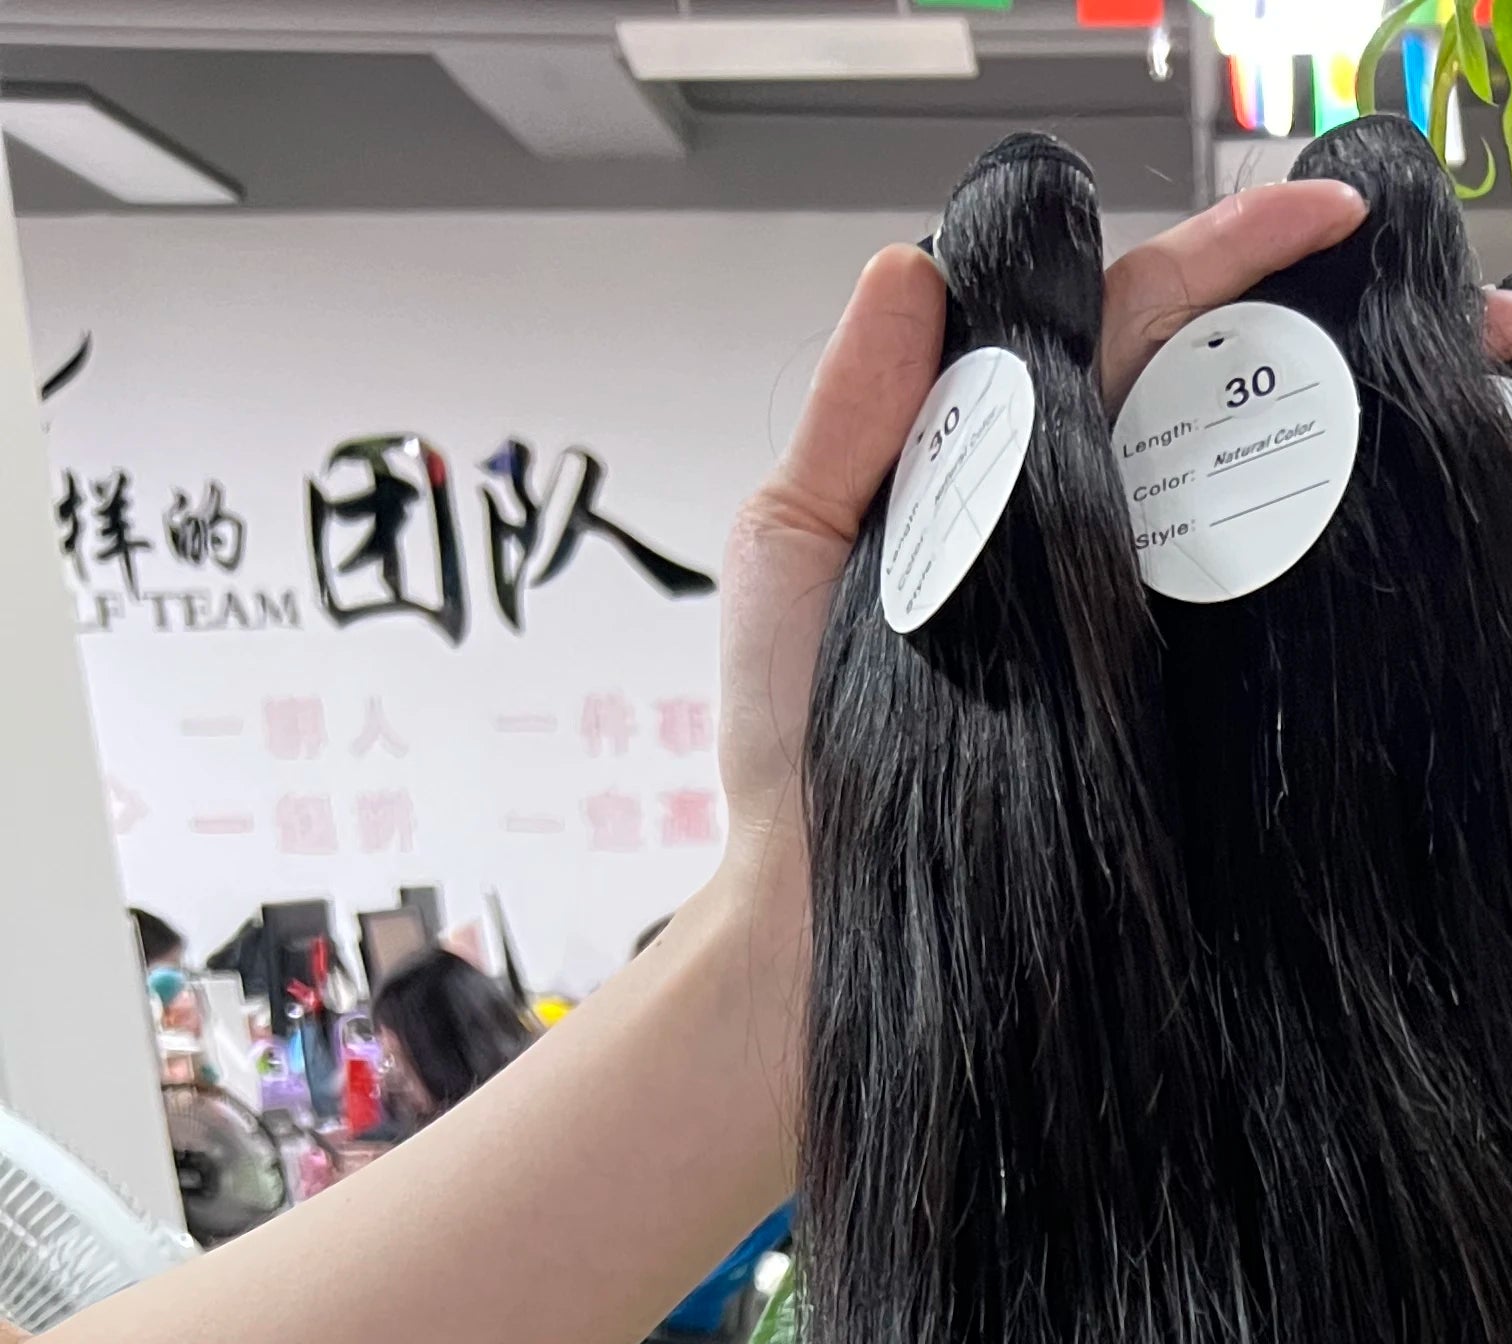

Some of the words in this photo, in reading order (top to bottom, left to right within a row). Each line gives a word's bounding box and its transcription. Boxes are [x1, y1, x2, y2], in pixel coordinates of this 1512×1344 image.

[930, 405, 960, 463] 30
[1122, 417, 1200, 458] Length:
[1224, 365, 1277, 409] 30
[1132, 469, 1196, 503] Color:
[1212, 434, 1272, 469] Natural
[1273, 419, 1317, 445] Color
[1134, 518, 1196, 550] Style:
[144, 588, 303, 632] TEAM
